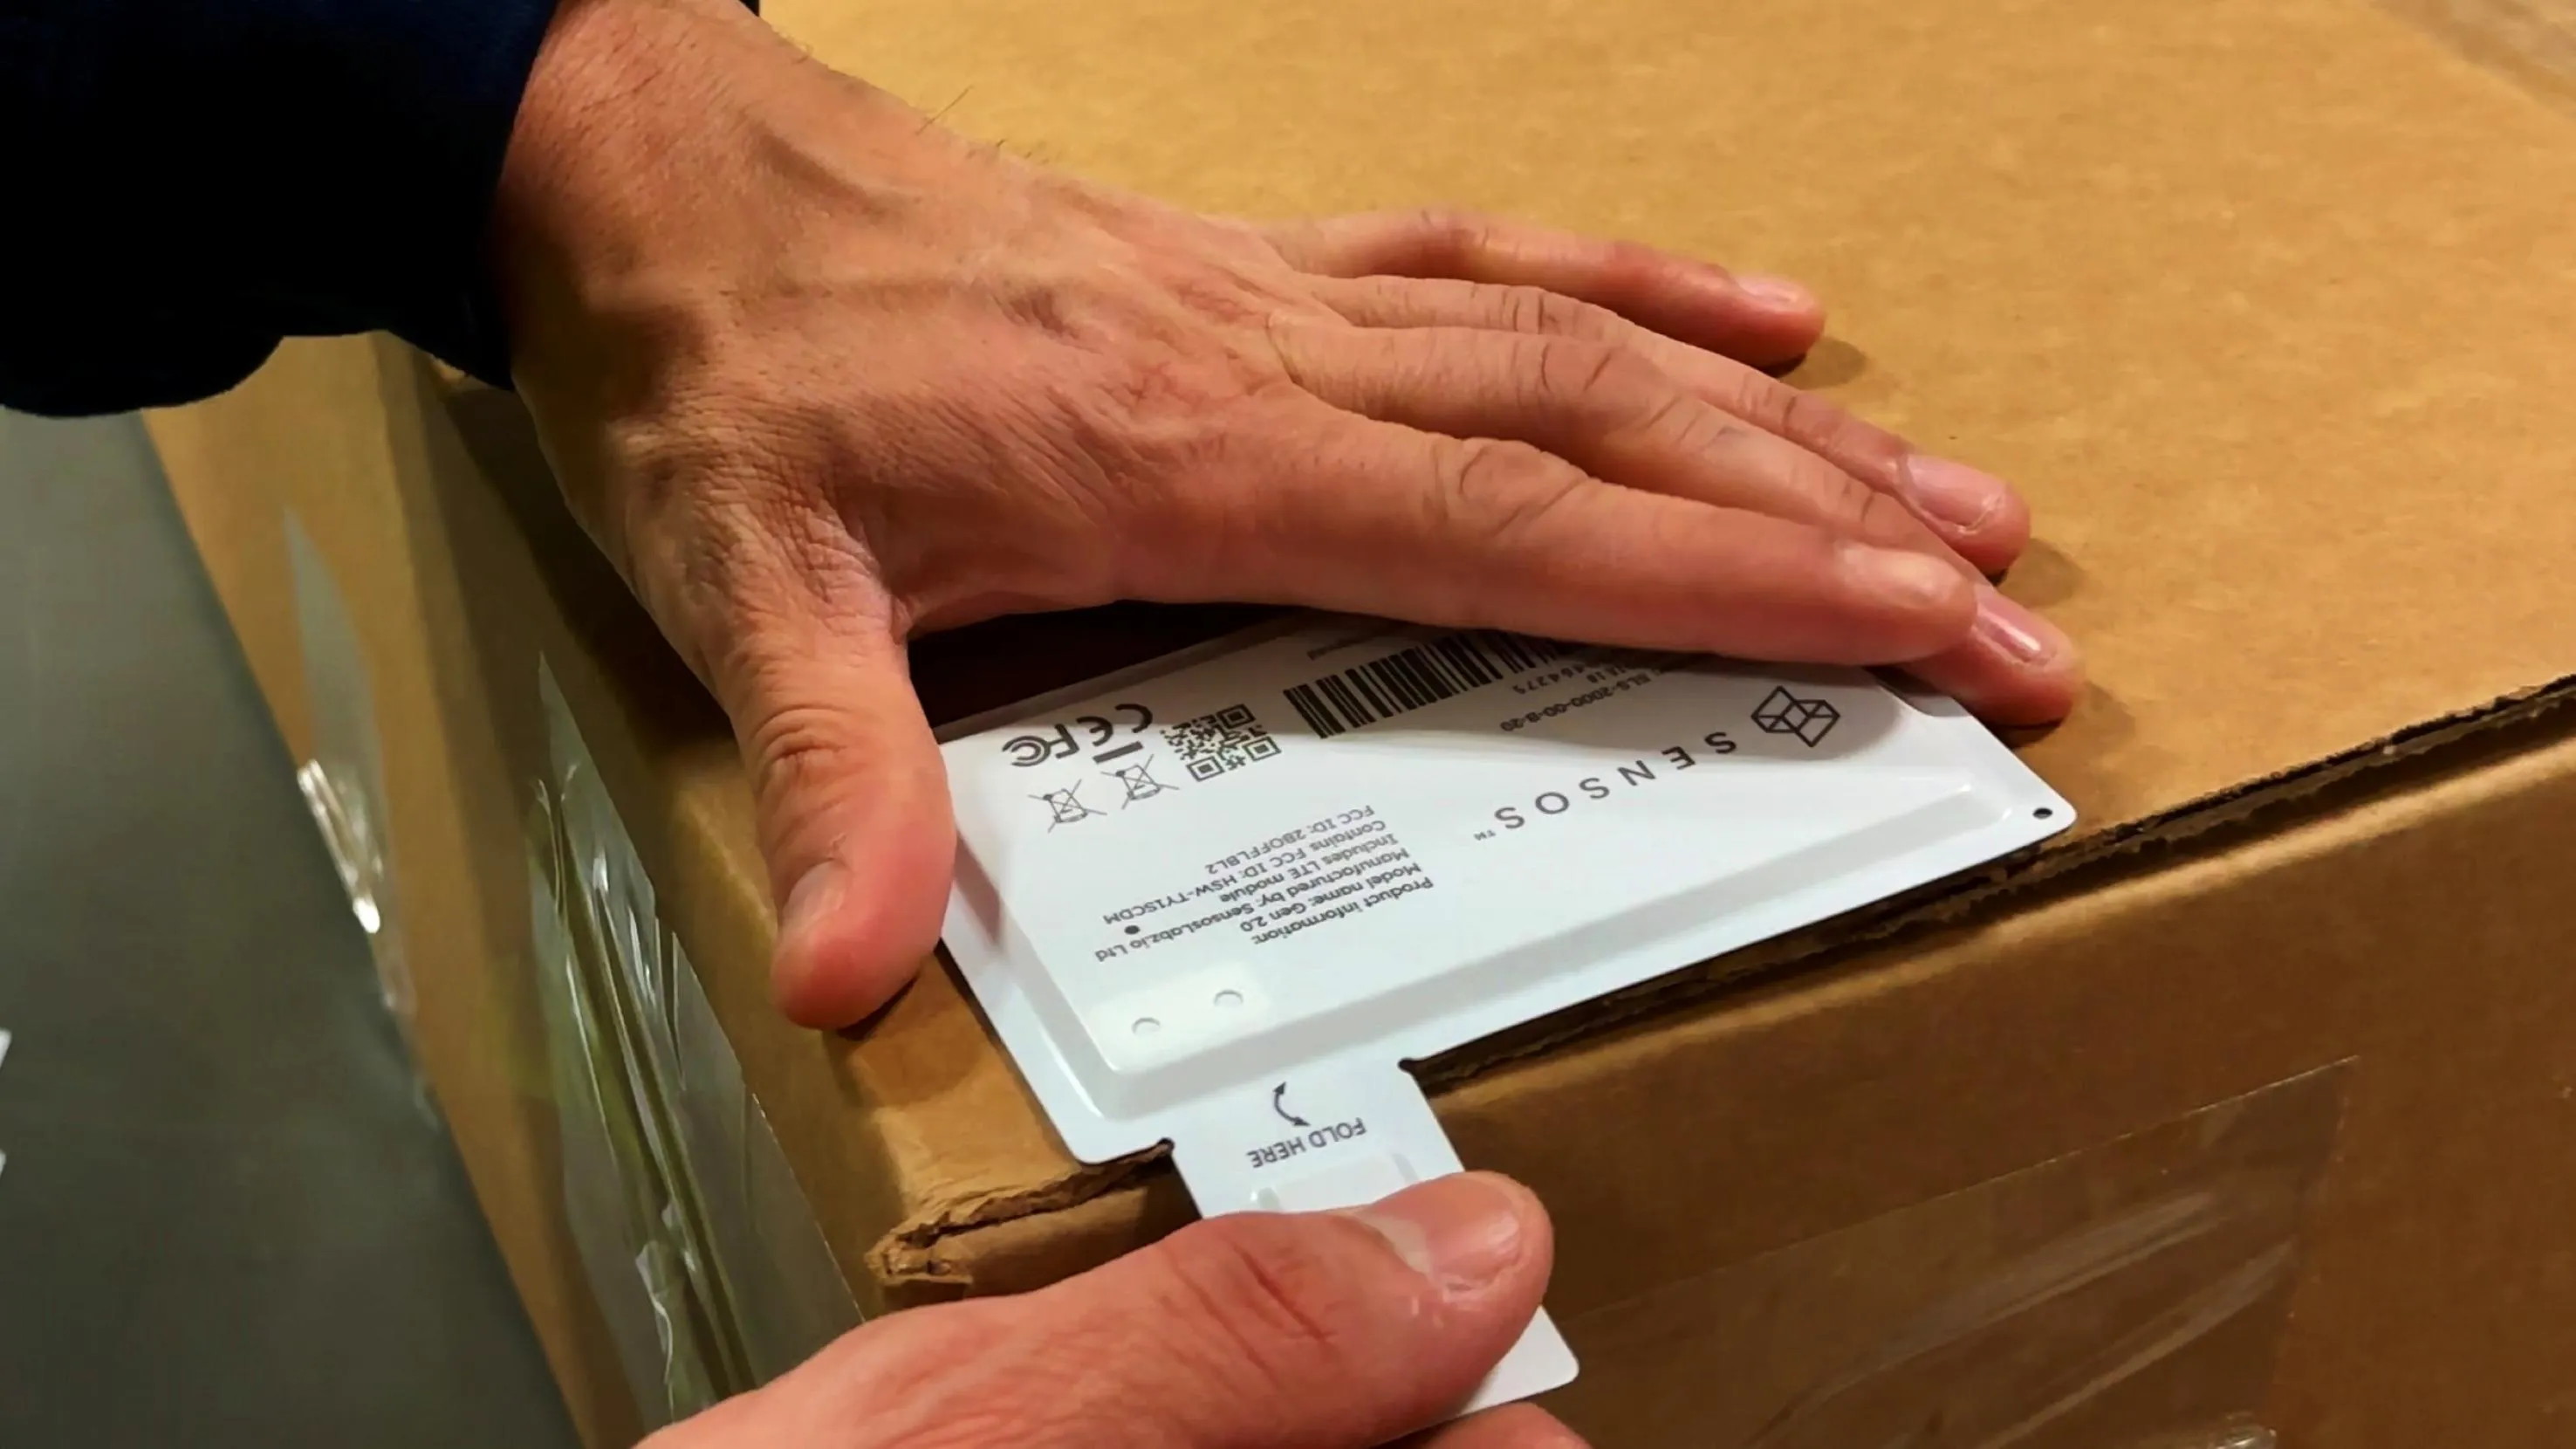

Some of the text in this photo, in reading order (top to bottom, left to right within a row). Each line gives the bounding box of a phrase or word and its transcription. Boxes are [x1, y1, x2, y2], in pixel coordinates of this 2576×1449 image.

[1076, 704, 1153, 746] CE
[1494, 731, 1737, 829] SENSOS
[1307, 819, 1337, 834] ID:
[1337, 805, 1374, 824] FCC
[1309, 820, 1386, 851] Contains
[1220, 834, 1398, 902] Includes LTE module
[1238, 862, 1268, 878] ID:
[1270, 848, 1307, 868] FCC
[1286, 848, 1409, 897] Manufactured
[1240, 862, 1422, 932] Model name: Gen 2.0
[1251, 877, 1434, 944] Product information:
[1256, 892, 1286, 907] by:
[1094, 944, 1128, 962] Ltd
[1246, 1117, 1367, 1168] FOLD HERE
